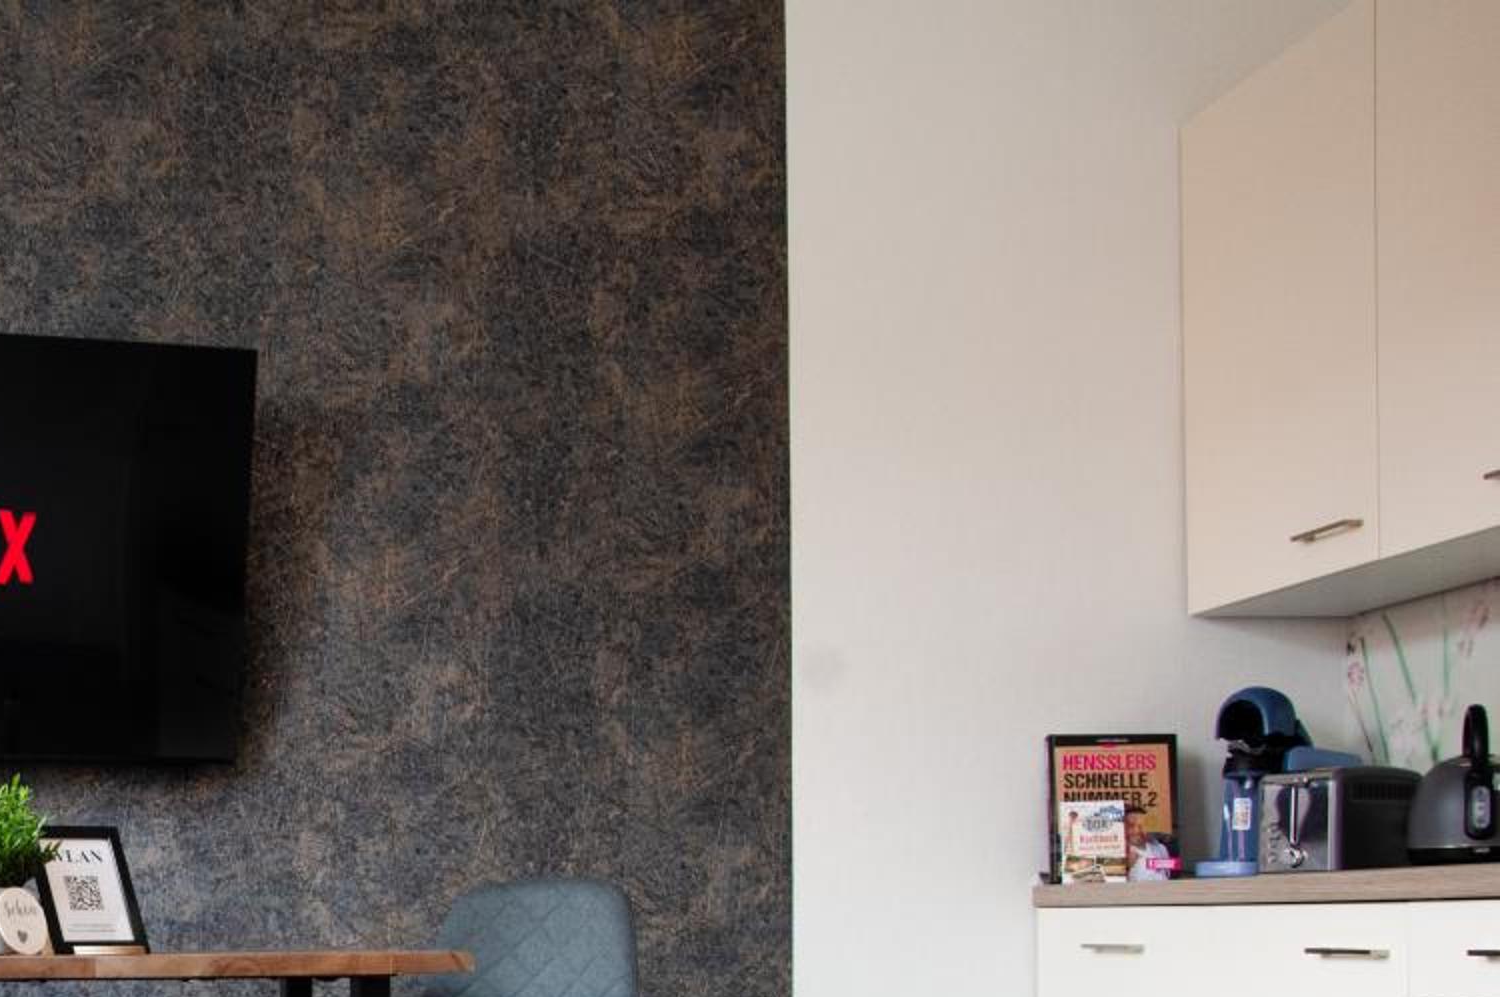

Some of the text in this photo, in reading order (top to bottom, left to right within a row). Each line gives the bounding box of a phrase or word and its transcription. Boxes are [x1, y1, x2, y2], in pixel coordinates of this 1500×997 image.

[1062, 753, 1157, 771] HENSSLERS
[1063, 772, 1149, 789] SCHNELLE
[53, 849, 102, 863] LAN
